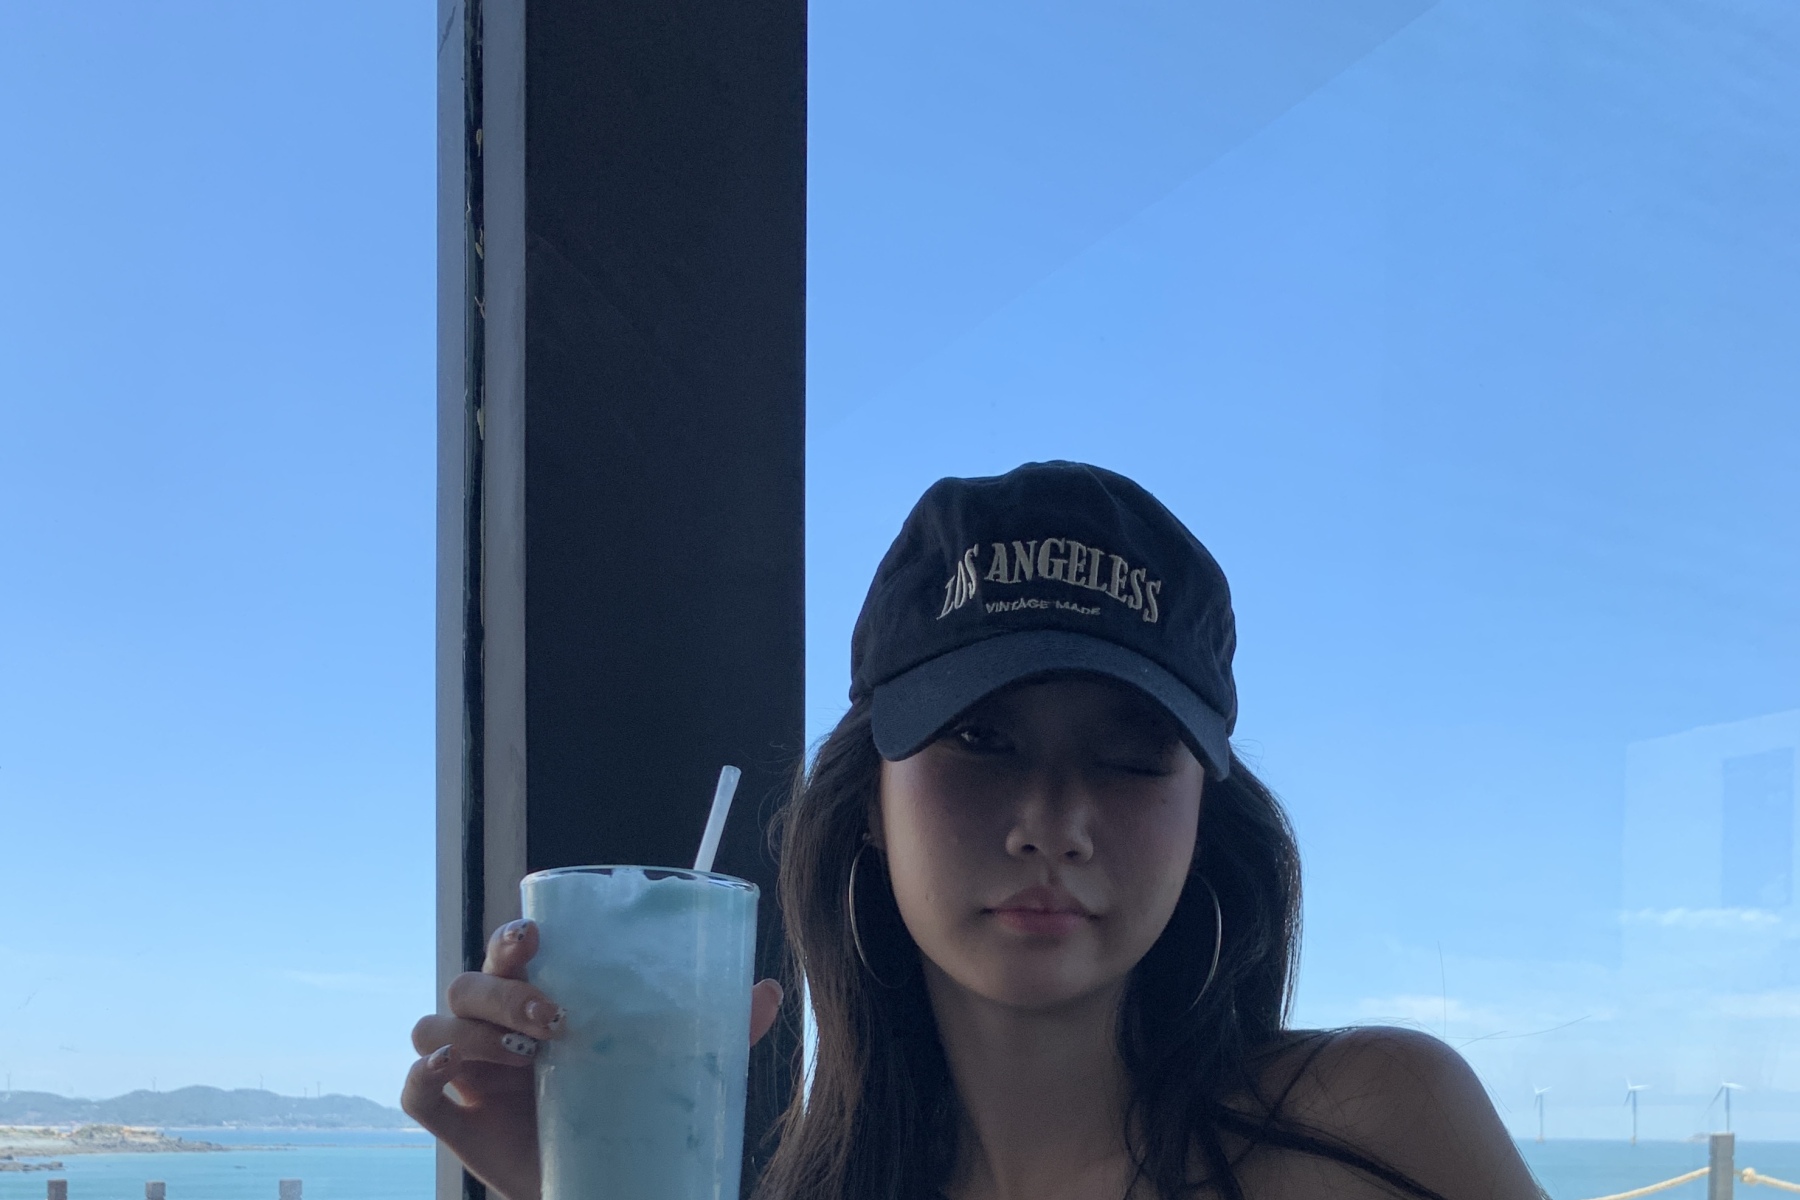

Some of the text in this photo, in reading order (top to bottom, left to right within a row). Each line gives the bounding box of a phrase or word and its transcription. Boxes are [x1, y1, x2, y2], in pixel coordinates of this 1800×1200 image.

[936, 537, 1162, 623] LOS ANGELESS
[985, 598, 1101, 616] VINTAGE MADE
